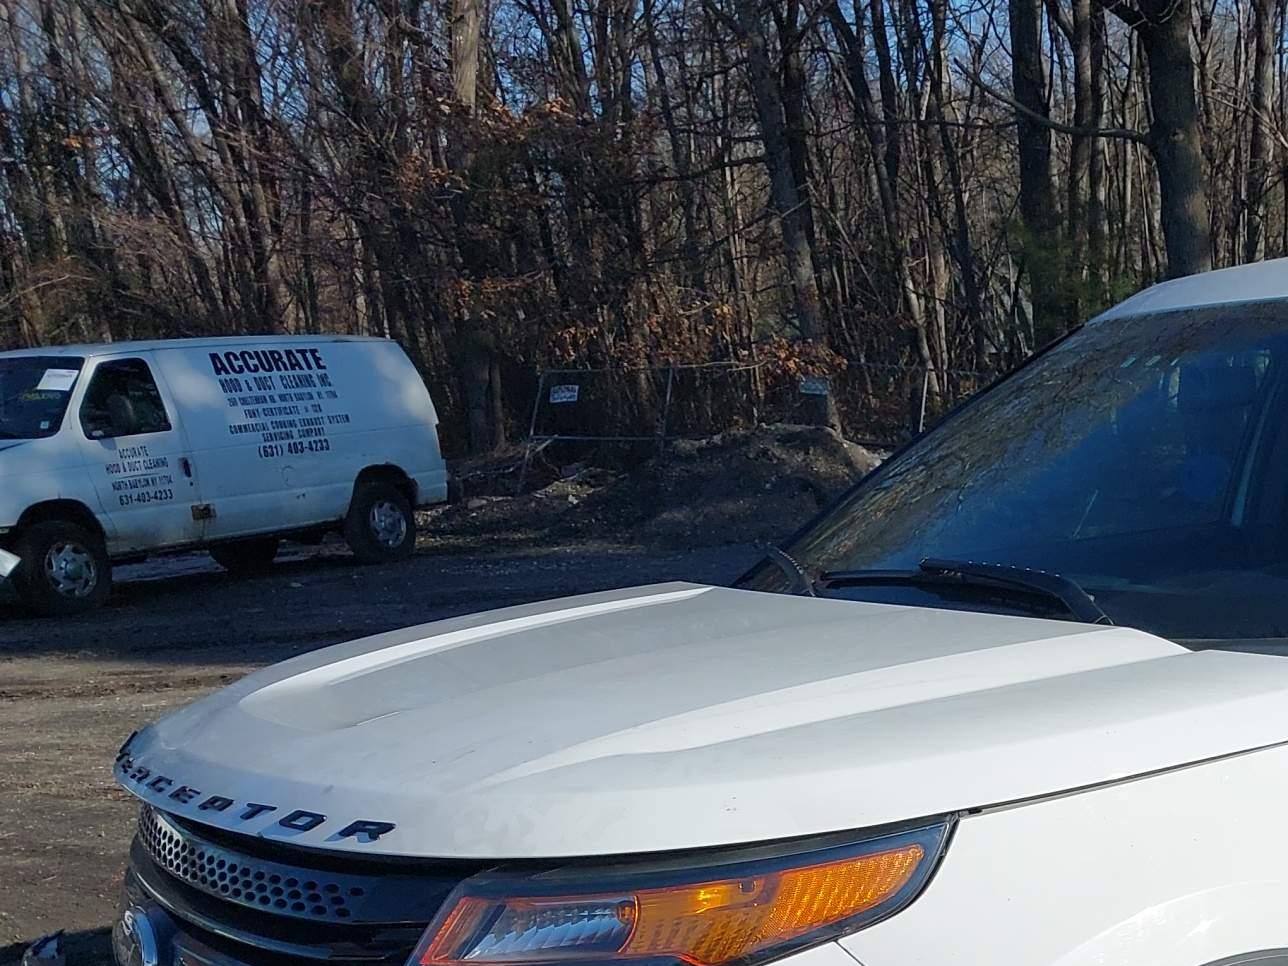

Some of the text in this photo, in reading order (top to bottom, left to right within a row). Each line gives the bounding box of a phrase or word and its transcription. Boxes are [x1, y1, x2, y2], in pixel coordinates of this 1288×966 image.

[208, 348, 327, 376] ACCURATE
[218, 377, 243, 394] HOOD
[244, 379, 253, 392] &
[253, 375, 276, 391] DUCT
[279, 373, 317, 390] CLEANING
[262, 405, 300, 417] CERTIFICATE
[229, 413, 350, 435] COMMERCIAL COOKING EXHAUST SYSTEM
[262, 427, 325, 442] SERVICING COMPANY
[119, 446, 149, 459] ACCURATE
[258, 438, 330, 459] (631) 403-4233
[119, 489, 174, 506] 631-403-4233
